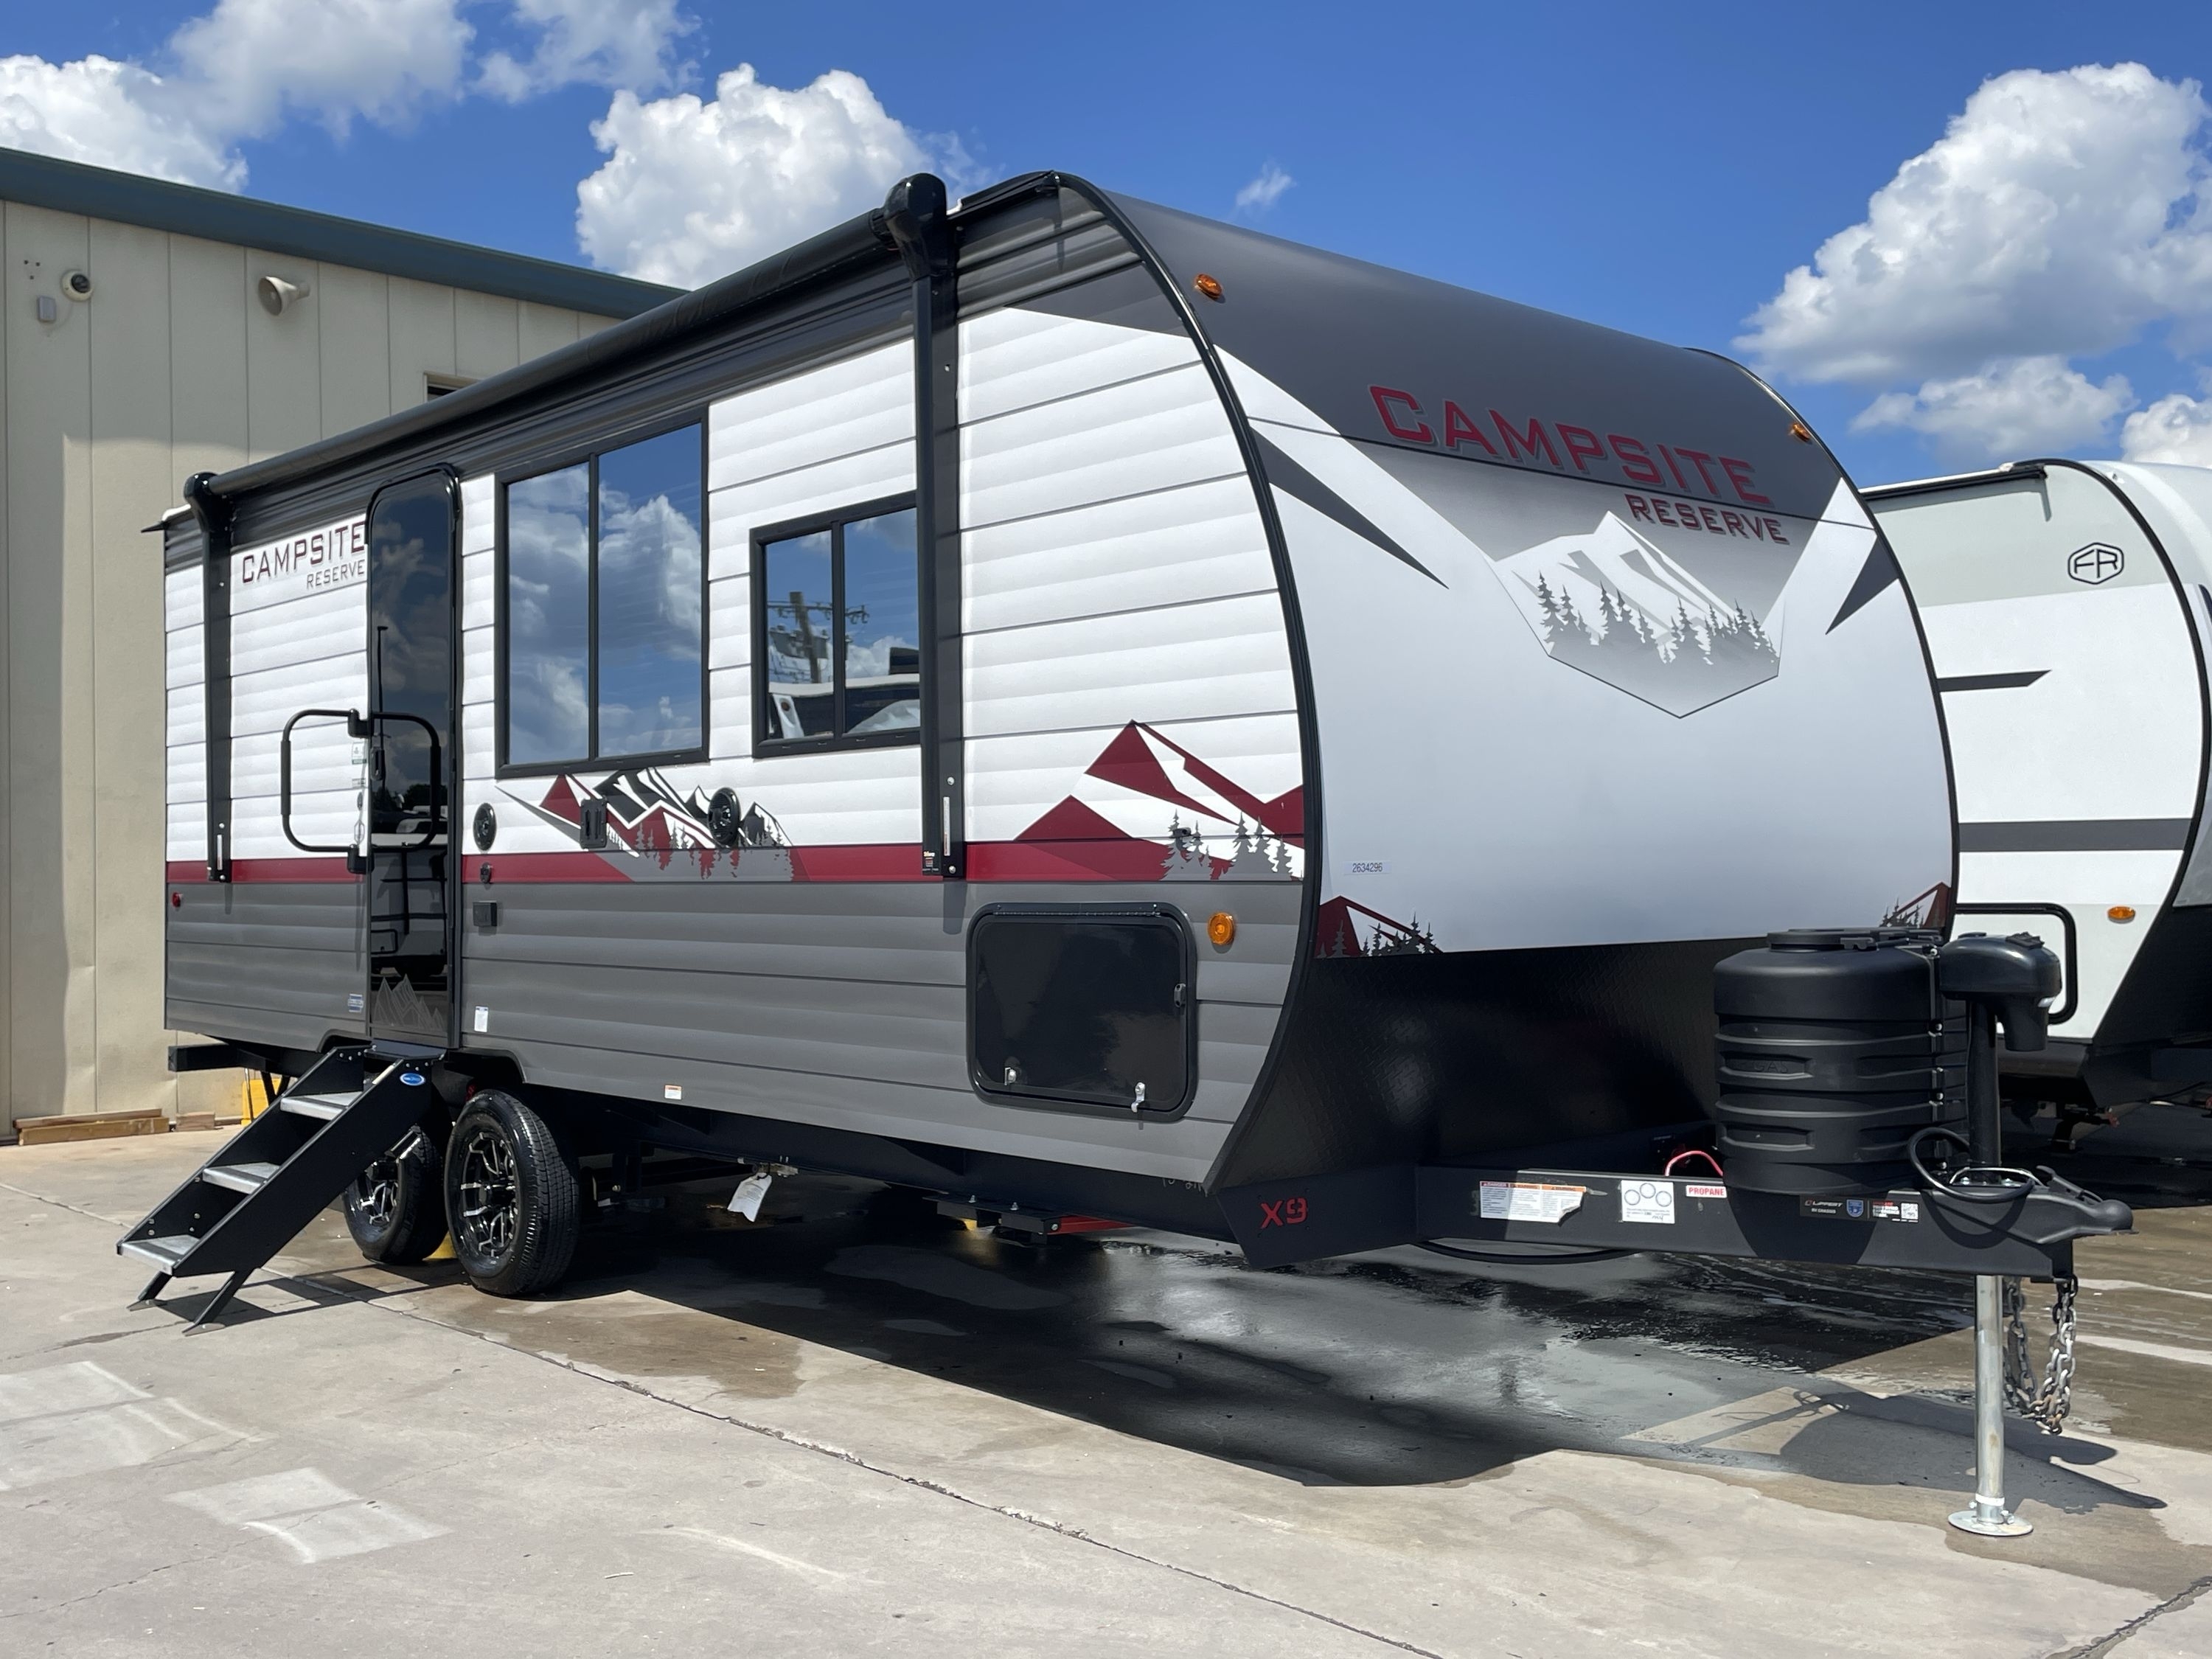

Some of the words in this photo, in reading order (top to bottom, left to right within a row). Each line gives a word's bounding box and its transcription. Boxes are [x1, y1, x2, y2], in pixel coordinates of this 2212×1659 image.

[1369, 386, 1773, 504] CAMPSITE
[1624, 493, 1790, 545] RESERVE
[242, 521, 366, 584] CAMPSITE
[307, 559, 366, 589] RESERVE
[1352, 862, 1383, 873] 2634296
[1688, 1187, 1725, 1196] PROPANE
[1260, 1197, 1307, 1229] X9
